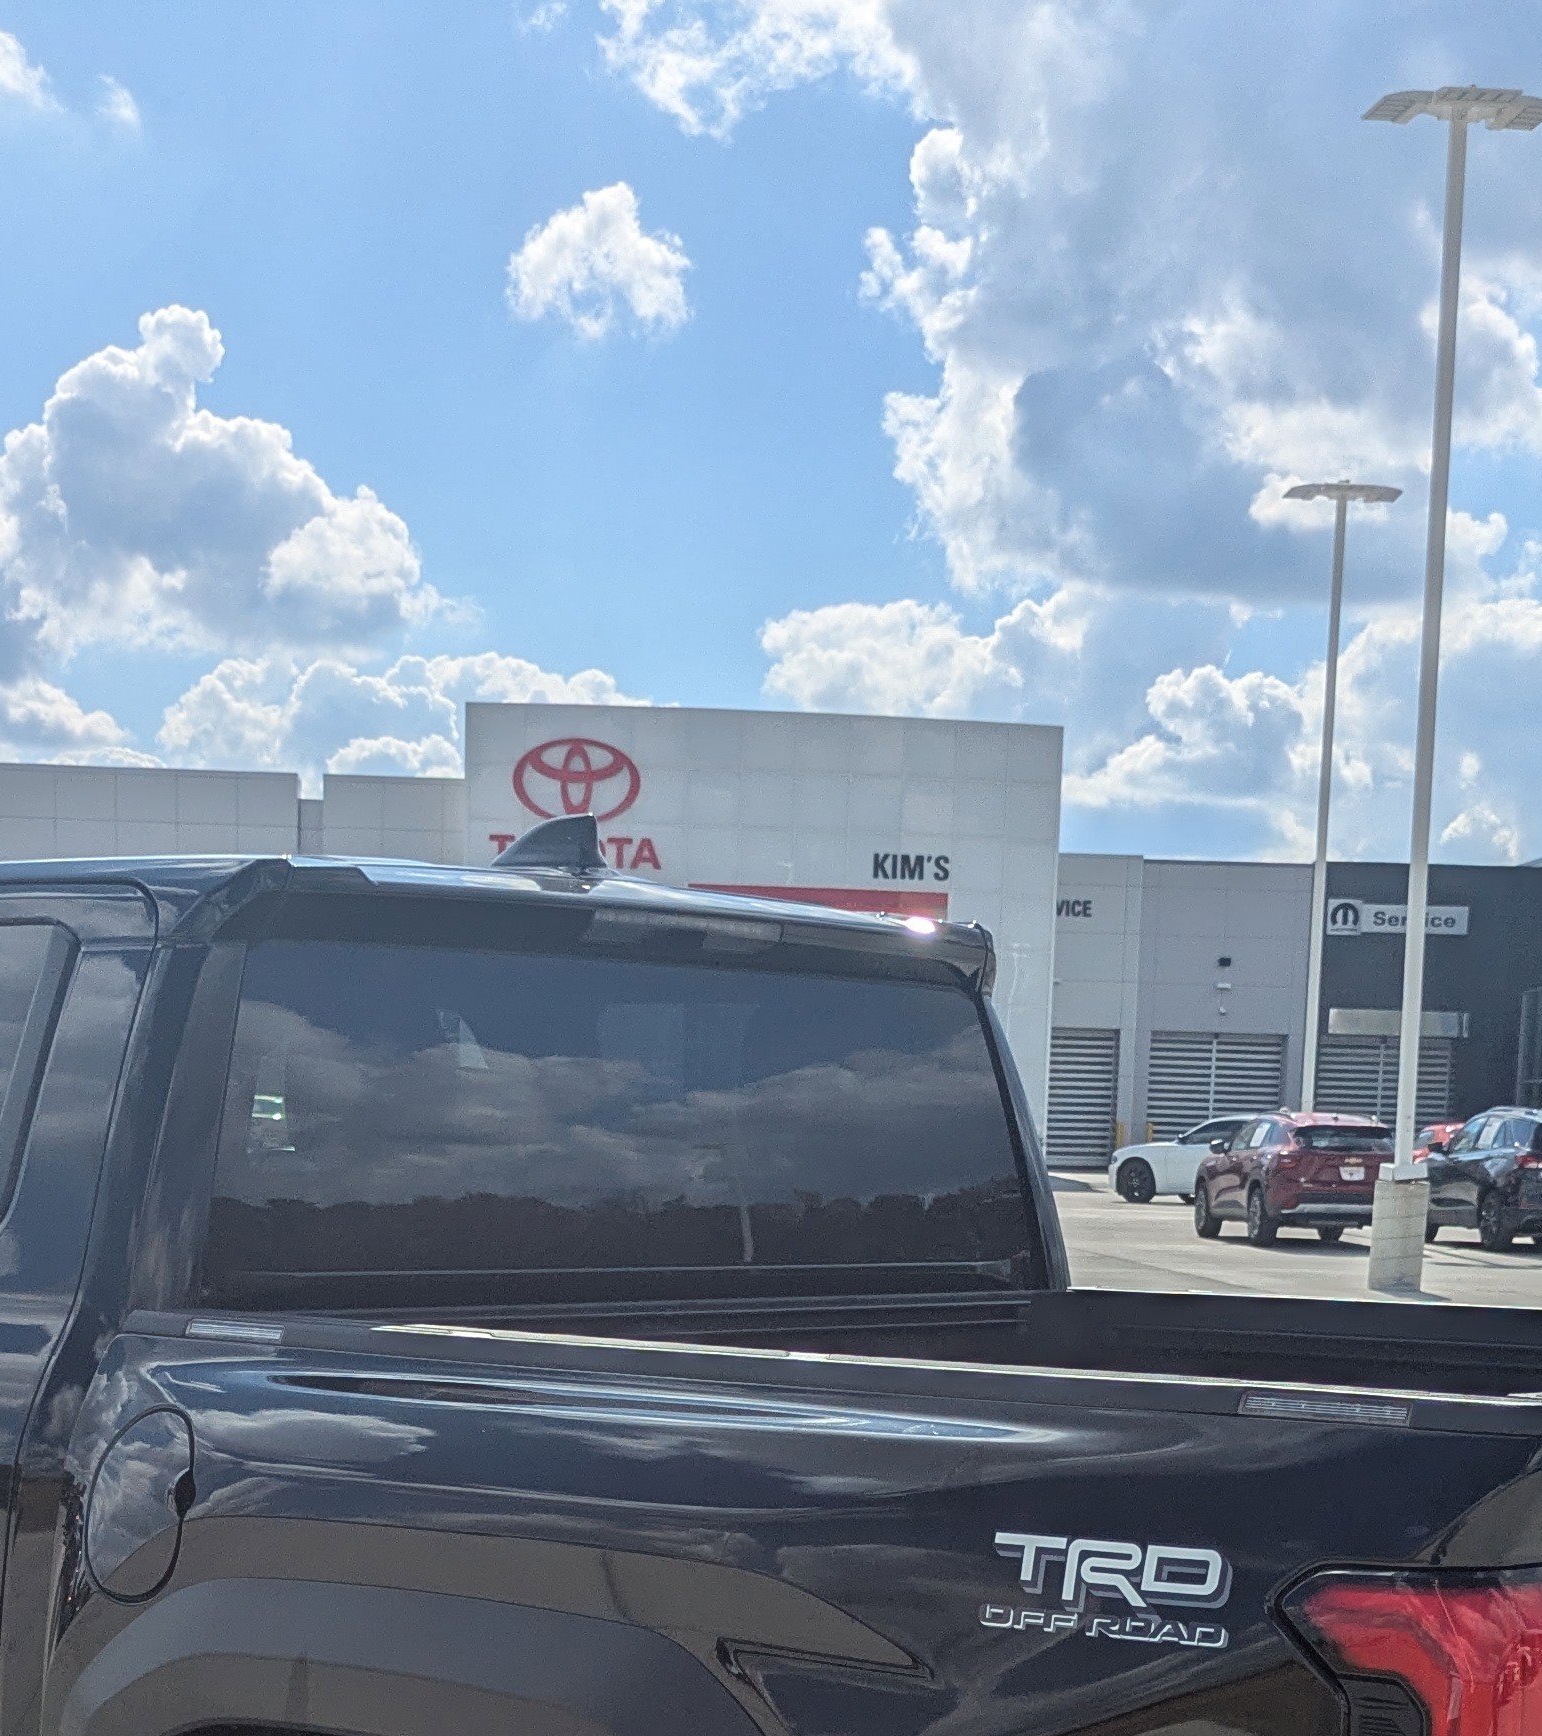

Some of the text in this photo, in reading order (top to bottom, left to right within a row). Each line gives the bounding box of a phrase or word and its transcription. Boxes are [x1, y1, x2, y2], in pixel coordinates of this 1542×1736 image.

[489, 834, 661, 869] TTA
[872, 853, 950, 881] KIM'S
[1372, 911, 1456, 928] Serice
[993, 1531, 1233, 1610] TRD
[978, 1602, 1229, 1649] OFF ROAD
